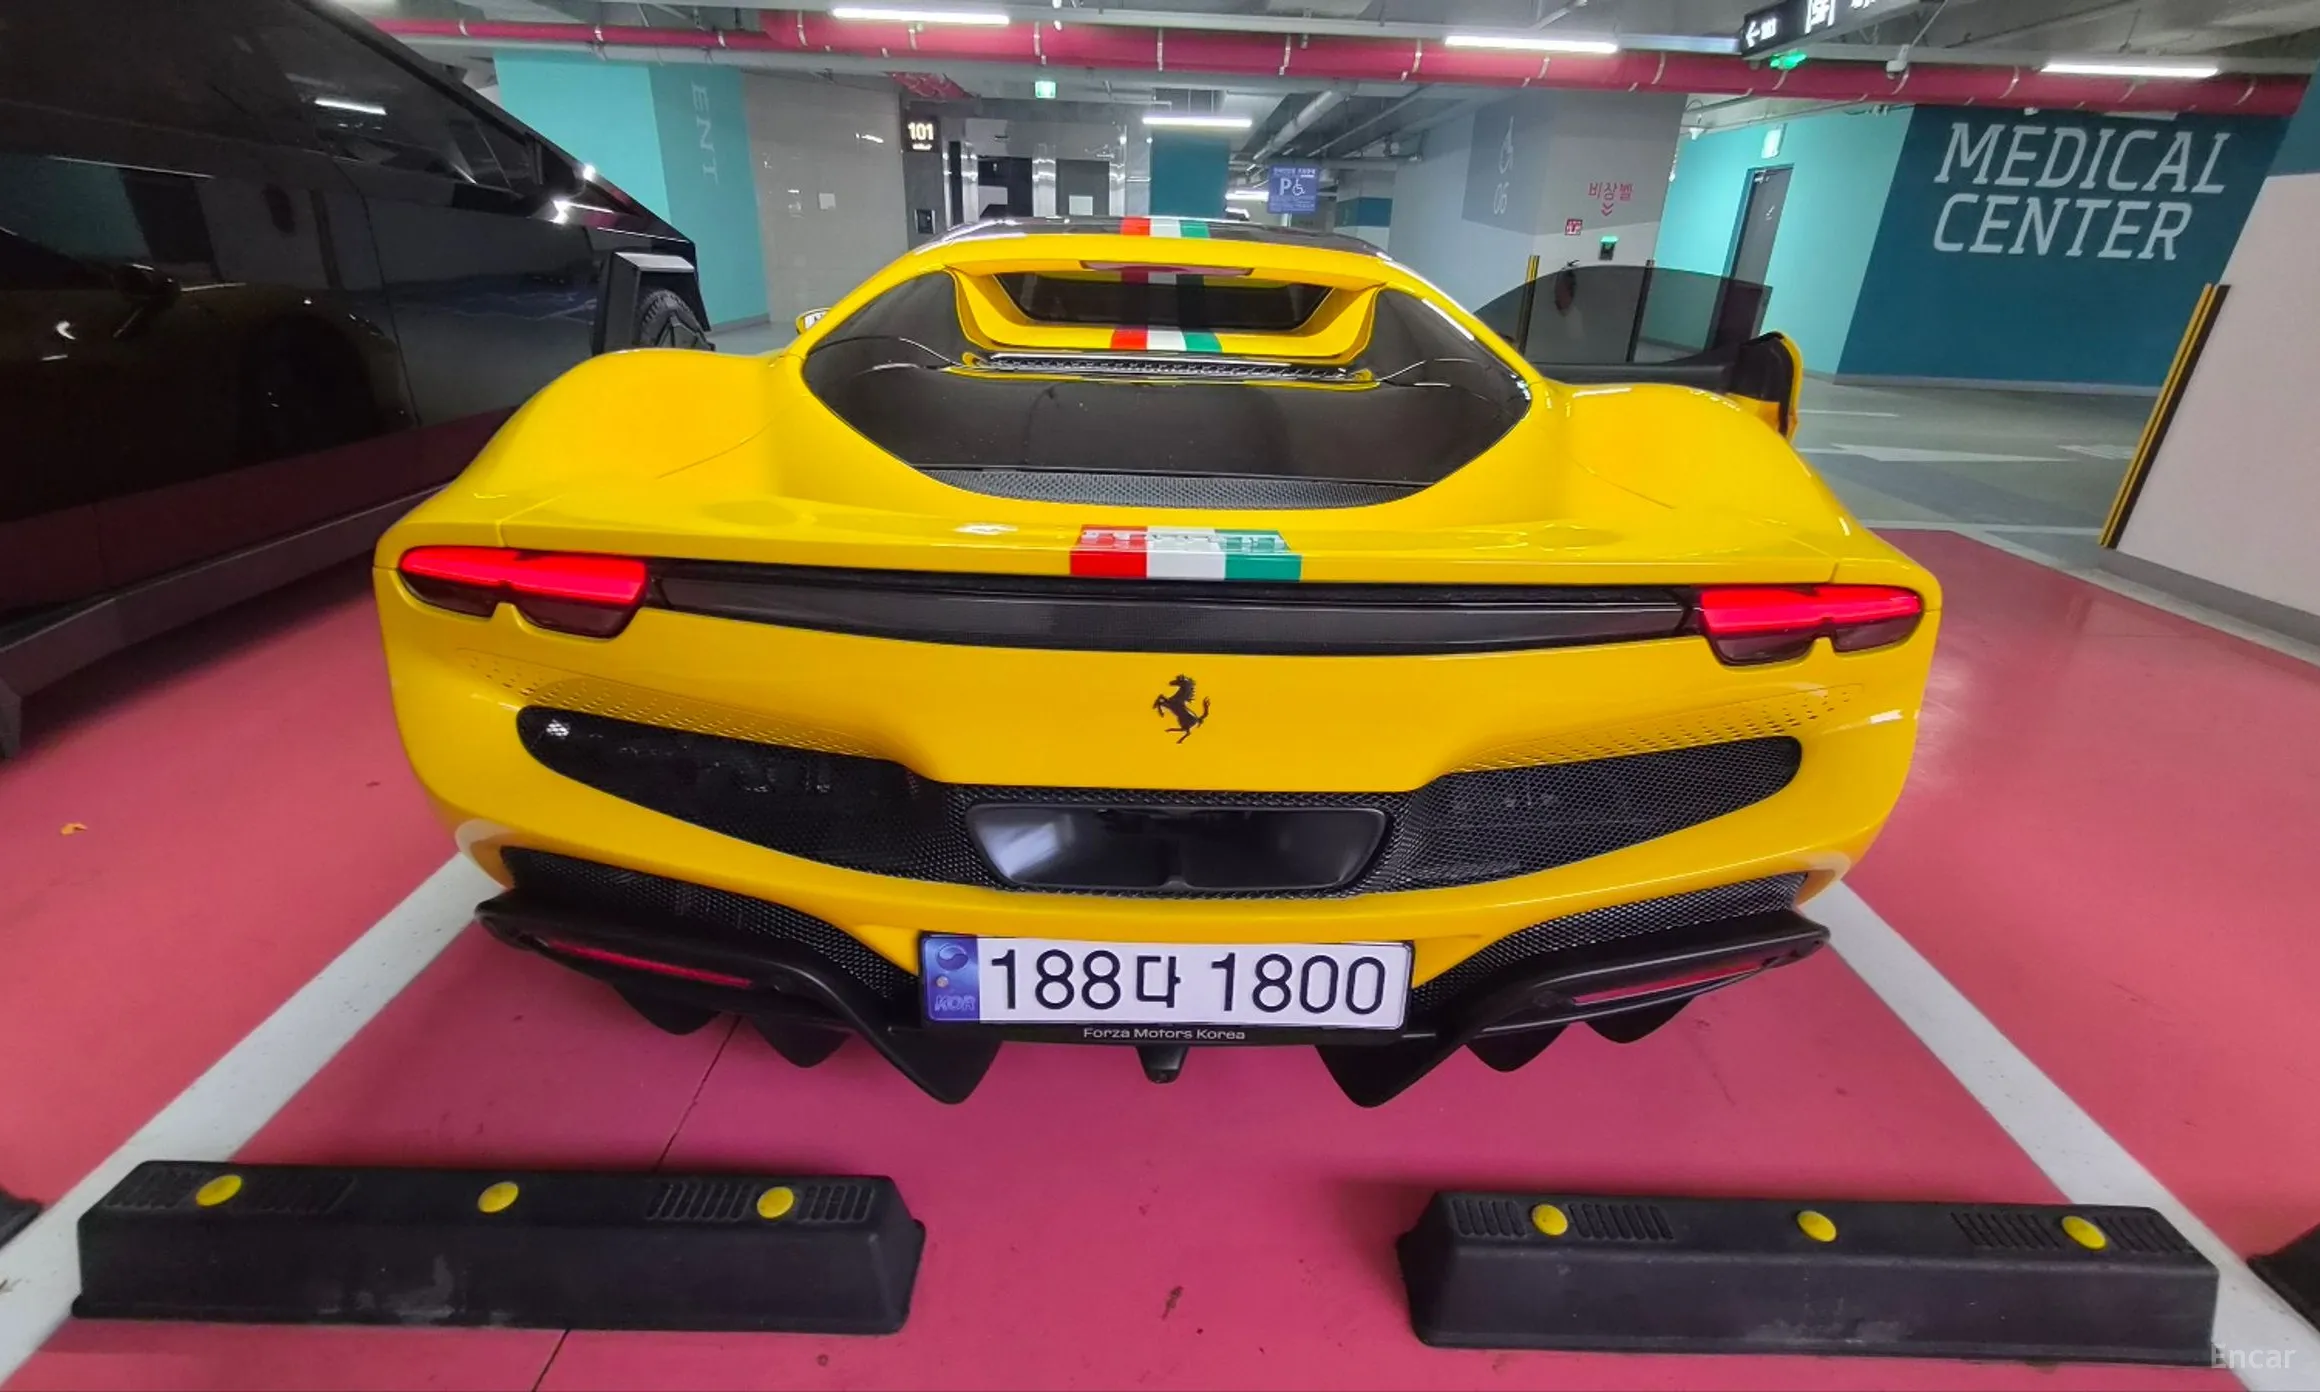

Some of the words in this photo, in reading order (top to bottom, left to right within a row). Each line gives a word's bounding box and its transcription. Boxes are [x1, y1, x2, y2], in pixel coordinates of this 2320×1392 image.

[907, 121, 934, 141] 101
[1933, 121, 2231, 194] MEDICAL
[1280, 177, 1292, 197] P
[1587, 181, 1634, 202] 비상벨
[1932, 193, 2193, 261] CENTER
[991, 948, 1181, 1010] 188다
[1211, 952, 1386, 1016] 1800
[934, 995, 976, 1012] KOR
[1083, 1027, 1131, 1039] Forza
[1134, 1028, 1193, 1040] Motors
[1197, 1028, 1246, 1040] Korea
